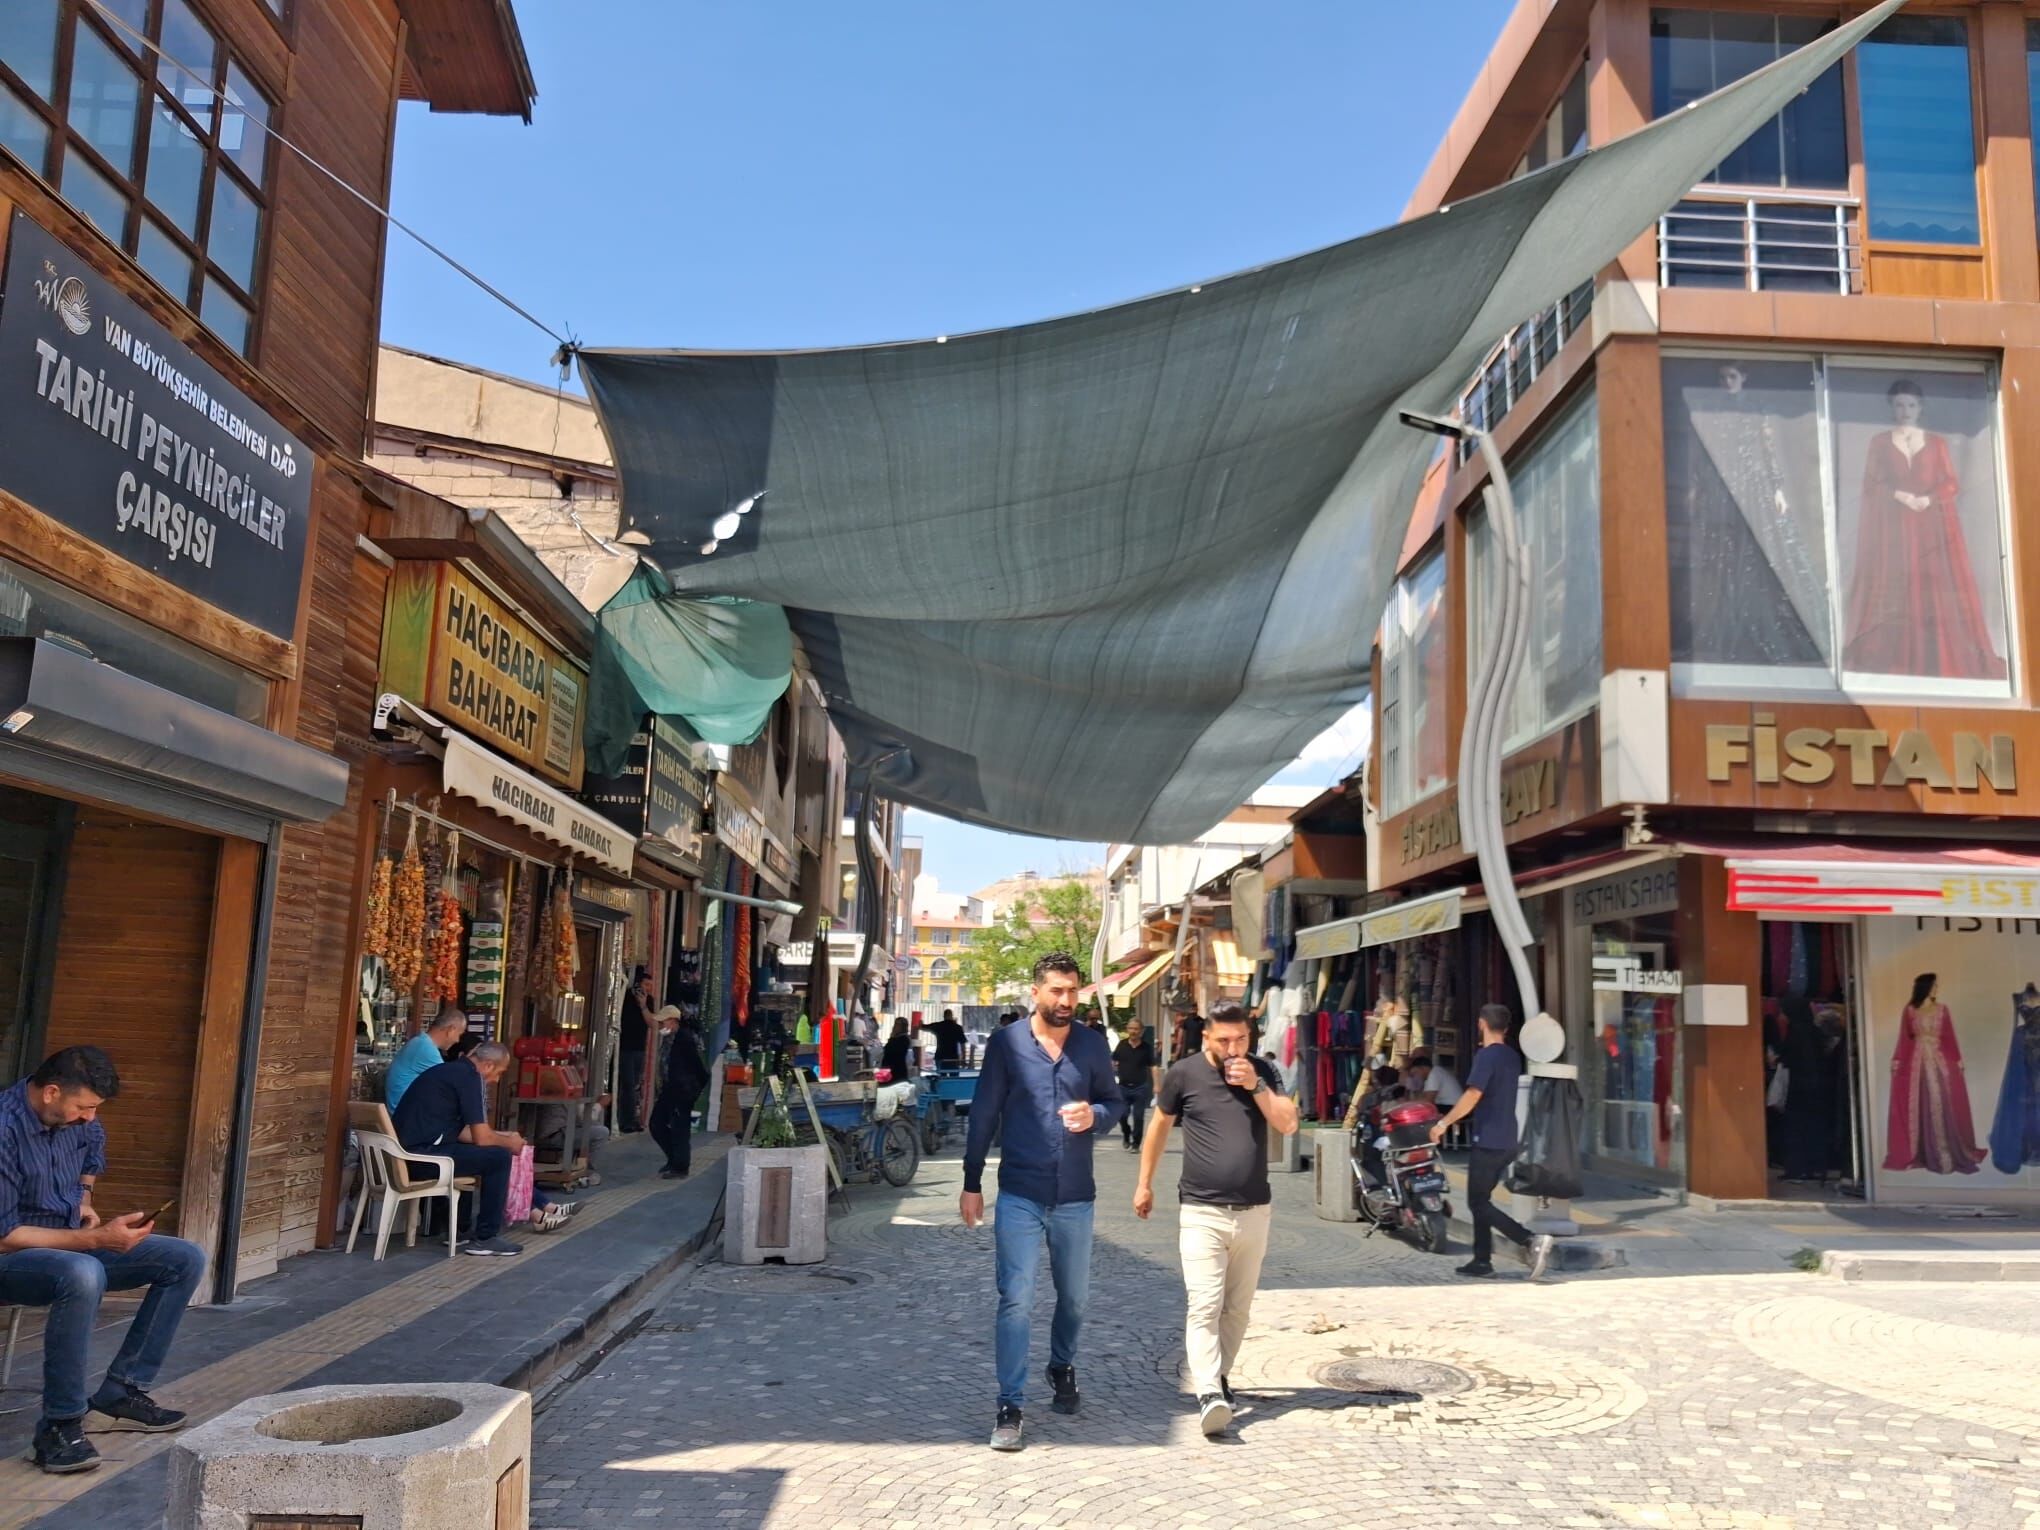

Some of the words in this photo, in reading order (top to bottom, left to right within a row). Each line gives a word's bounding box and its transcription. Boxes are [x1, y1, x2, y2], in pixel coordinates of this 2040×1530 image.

[104, 315, 132, 357] VAN
[133, 339, 209, 417] BÜYÜKŞEHİR
[209, 398, 267, 460] BELEDİYESİ
[35, 337, 135, 450] TARİHİ
[137, 412, 286, 550] PEYNİRCİLER
[116, 471, 217, 568] ÇARŞISI
[446, 585, 546, 701] HACIBABA
[448, 657, 538, 751] BAHARAT
[1706, 712, 2017, 793] FİSTAN
[570, 819, 612, 857] BAHARAT
